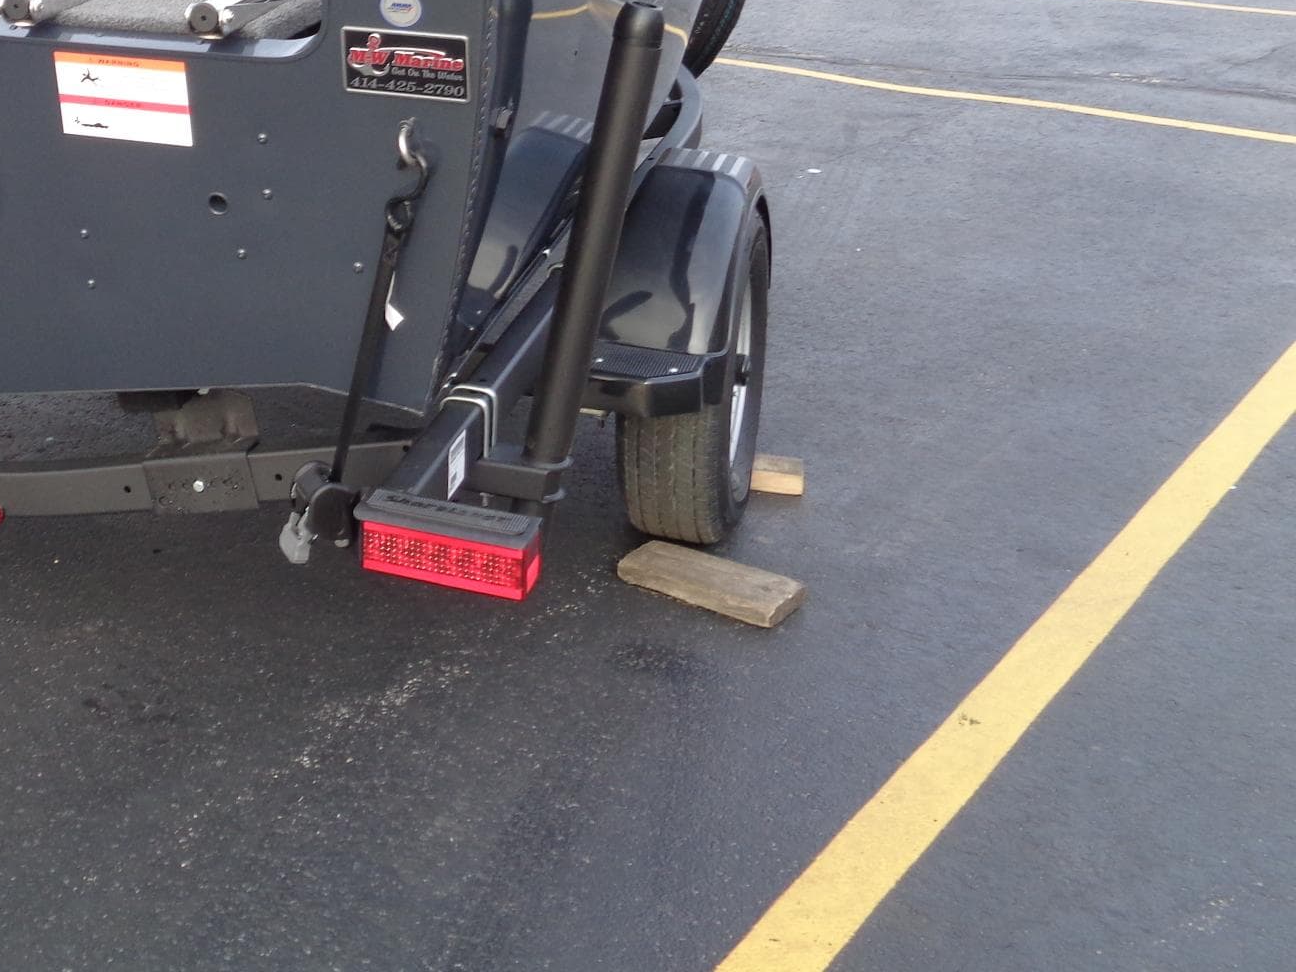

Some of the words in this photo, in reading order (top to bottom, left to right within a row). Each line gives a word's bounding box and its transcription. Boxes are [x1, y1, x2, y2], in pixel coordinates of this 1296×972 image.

[392, 51, 464, 71] Marine
[391, 67, 406, 76] Get
[422, 69, 436, 78] The
[351, 76, 464, 97] 414-425-2790
